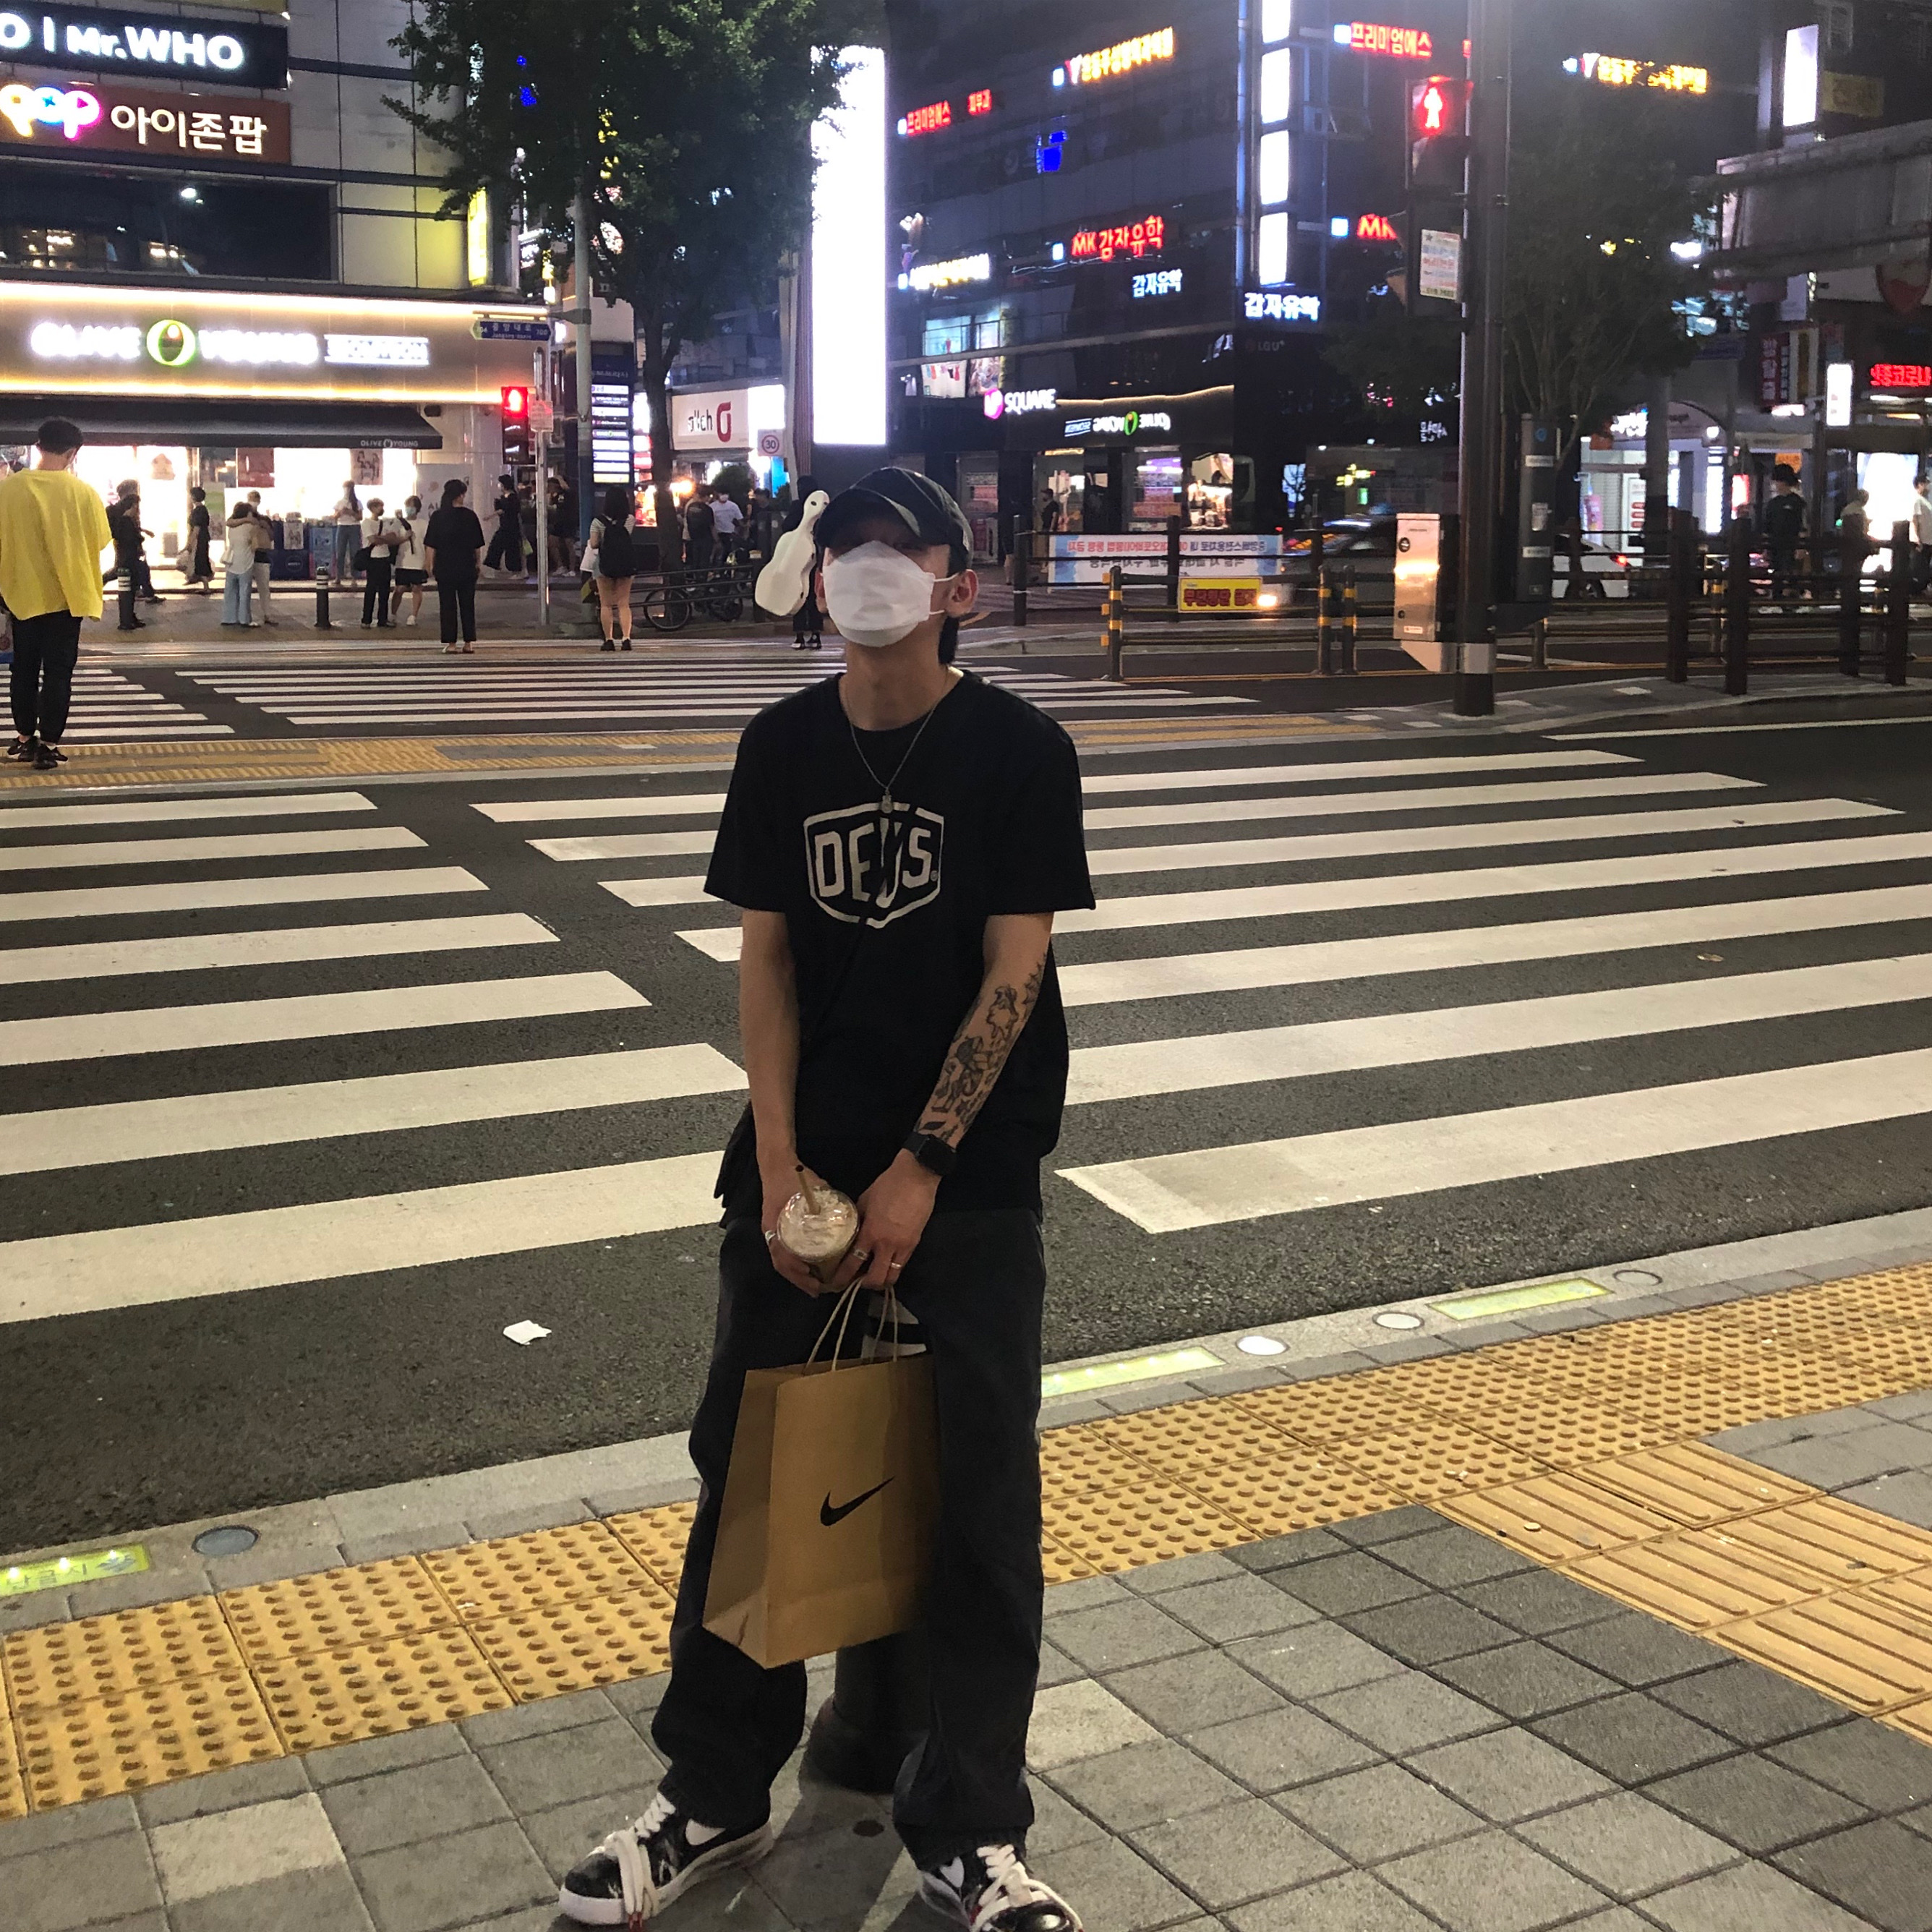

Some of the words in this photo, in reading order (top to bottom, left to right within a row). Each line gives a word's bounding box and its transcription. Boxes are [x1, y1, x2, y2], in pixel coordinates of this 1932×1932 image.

[67, 25, 244, 69] Mr.WHO
[1351, 22, 1432, 58] 프리미엄에스
[907, 100, 951, 135] 프리미엄에스
[1072, 231, 1096, 256] MK
[1099, 215, 1164, 261] 감자유학
[1132, 268, 1182, 297] 감자유학
[1244, 292, 1320, 320] 감자유학
[1004, 388, 1056, 415] SQUARE
[766, 440, 776, 449] 30
